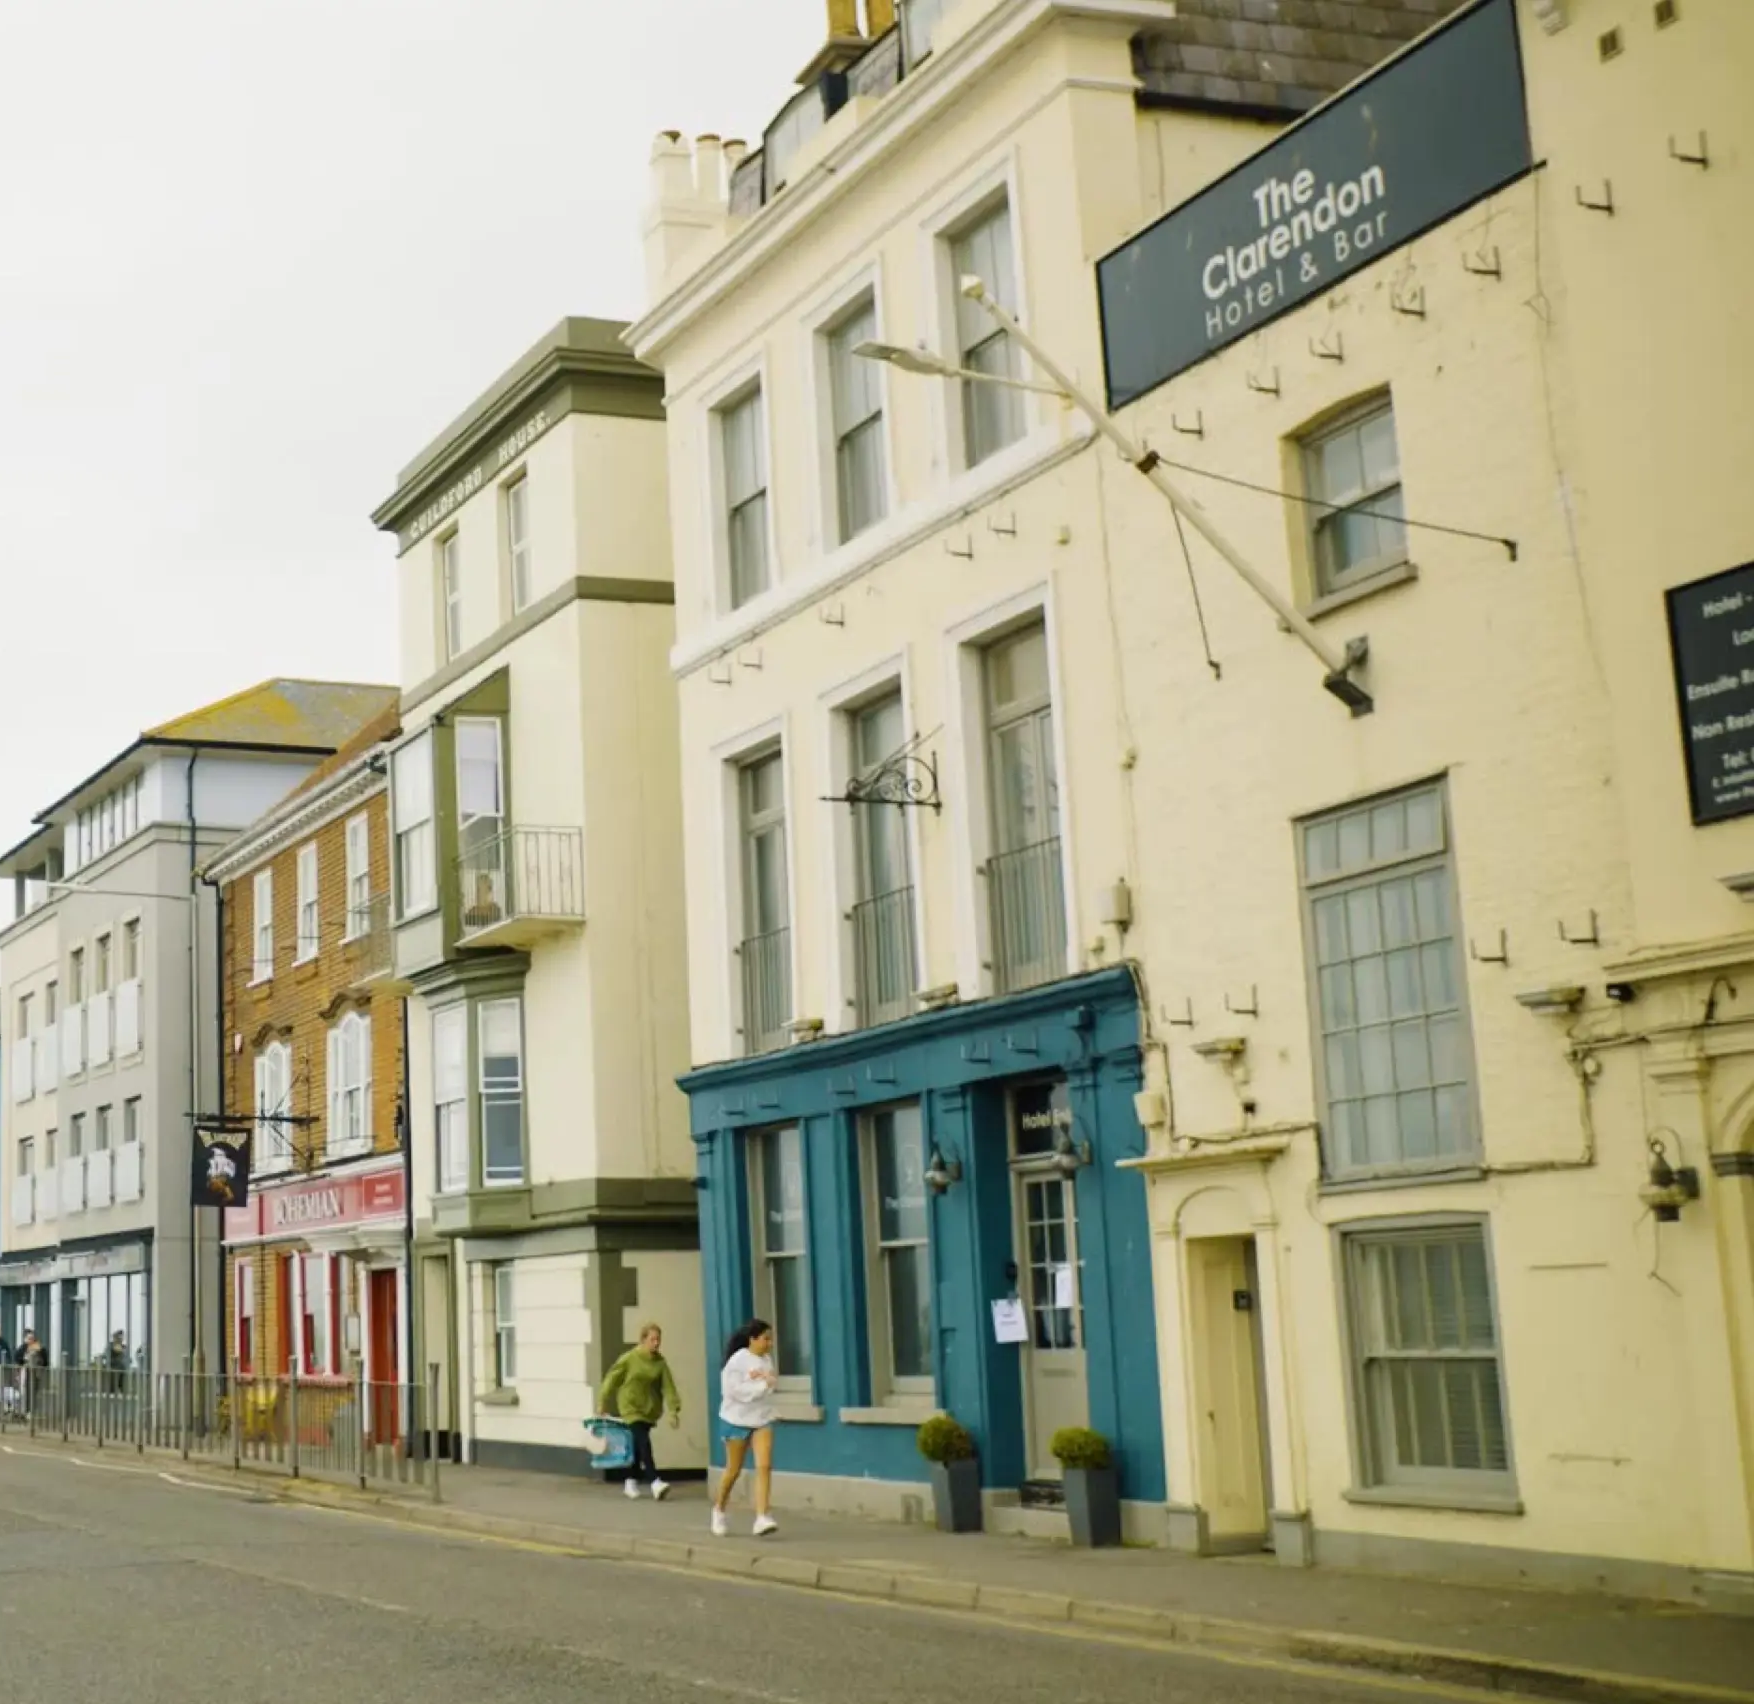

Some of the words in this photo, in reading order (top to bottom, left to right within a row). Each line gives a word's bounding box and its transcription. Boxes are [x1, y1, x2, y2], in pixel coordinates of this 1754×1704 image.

[1202, 165, 1386, 300] Clarendon
[1252, 168, 1315, 228] The
[1205, 267, 1284, 340] Hotel
[1299, 251, 1319, 284] &
[1333, 210, 1388, 263] Bar
[1691, 721, 1724, 742] Non
